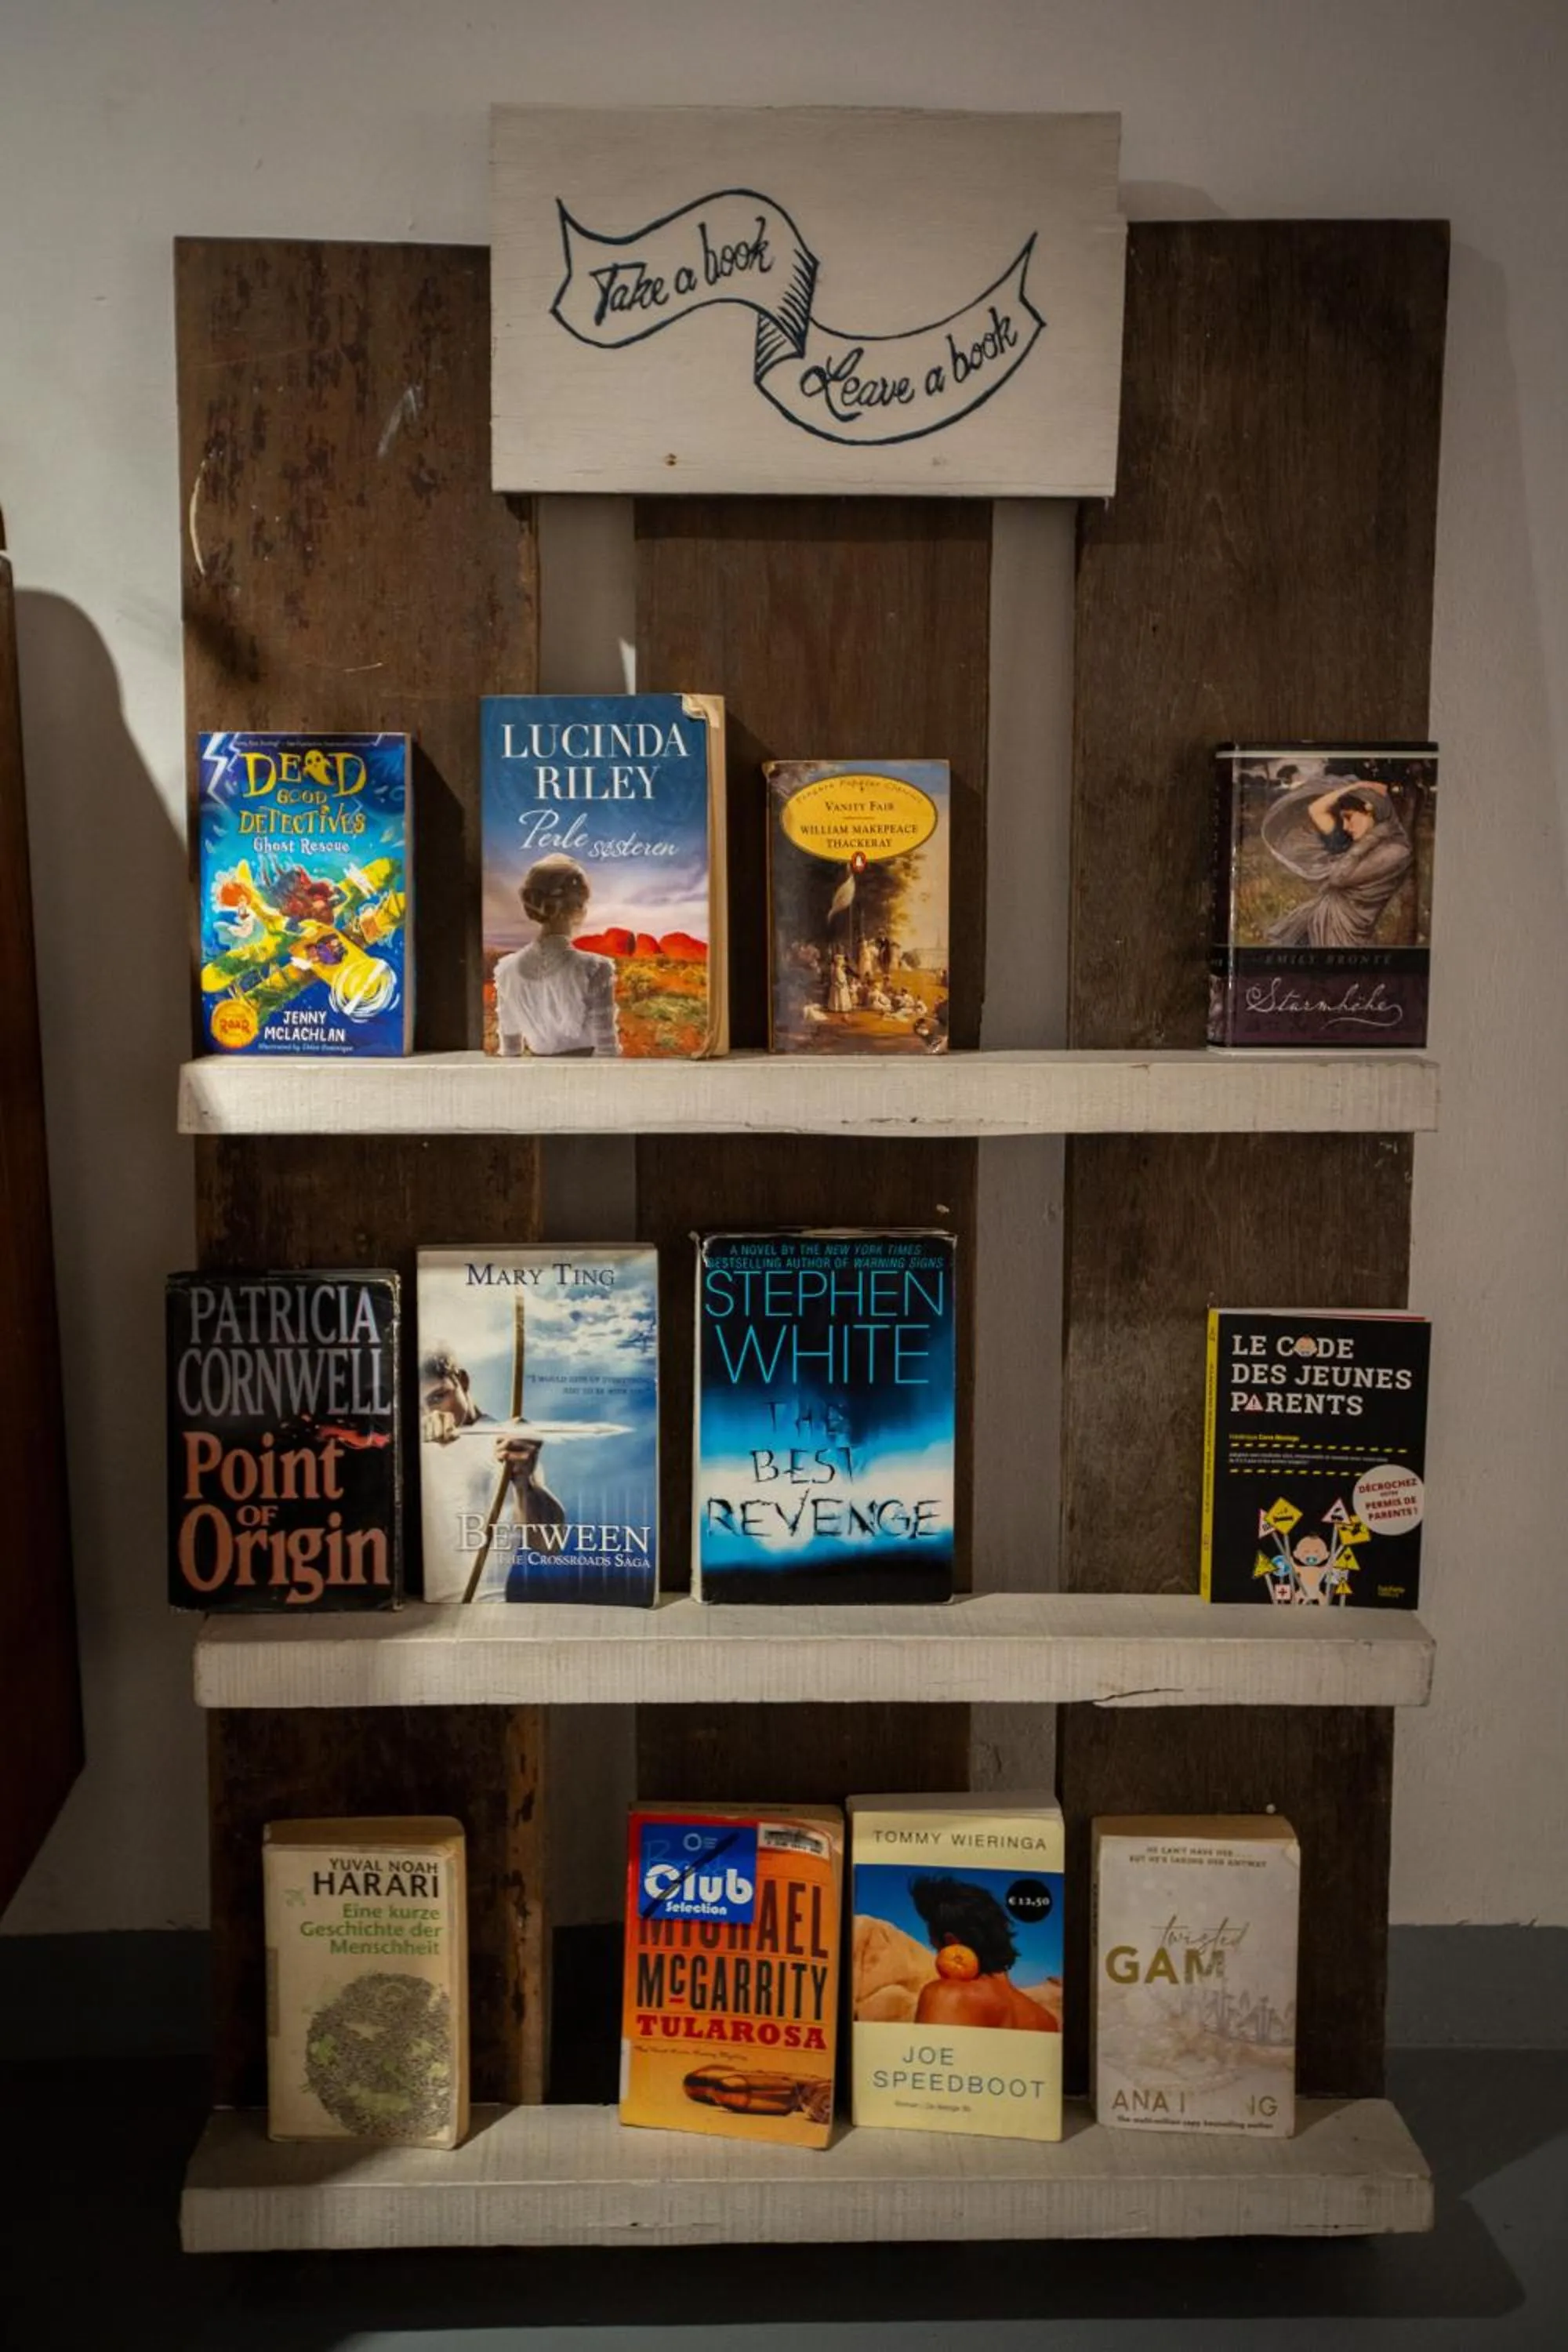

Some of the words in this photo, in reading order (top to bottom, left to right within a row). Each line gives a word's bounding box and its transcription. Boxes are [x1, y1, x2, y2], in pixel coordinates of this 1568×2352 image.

[590, 262, 667, 325] Take
[675, 267, 697, 294] a
[698, 217, 774, 285] book
[800, 347, 914, 422] Leave
[925, 365, 946, 394] a
[948, 307, 1018, 383] book
[501, 722, 691, 758] LUCINDA
[534, 766, 661, 800] RILEY
[277, 788, 328, 805] GOOD
[518, 809, 589, 850] Perle
[800, 825, 848, 835] WILLIAM
[852, 824, 917, 834] MAKEPEACE
[253, 836, 295, 854] Ghost
[300, 837, 350, 855] Rescue
[827, 838, 892, 848] THACKERAY
[283, 1011, 327, 1025] JENNY
[264, 1026, 346, 1042] MCLACHLAN
[730, 1245, 738, 1254] A
[742, 1245, 777, 1254] NOVEL
[781, 1245, 795, 1254] BY
[799, 1245, 819, 1254] THE
[826, 1245, 851, 1254] NEW
[854, 1245, 883, 1254] YORK
[887, 1245, 922, 1254] TIMES
[465, 1263, 543, 1287] MARY
[552, 1263, 615, 1287] TING
[706, 1258, 781, 1269] BESTSELLING
[786, 1258, 830, 1269] AUTHOR
[834, 1258, 848, 1269] OF
[853, 1258, 906, 1269] WARNING
[909, 1258, 944, 1269] SIGNS
[706, 1270, 943, 1317] STEPHEN
[191, 1285, 381, 1344] PATRICIA
[715, 1324, 930, 1385] WHITE
[1232, 1334, 1267, 1356] LE
[177, 1347, 391, 1417] CORNWELL
[1232, 1364, 1287, 1385] DES
[1295, 1366, 1413, 1390] JEUNES
[766, 1401, 847, 1441] THE
[182, 1431, 345, 1501] Point
[750, 1446, 855, 1484] BEST
[707, 1489, 942, 1540] REVENGE
[1365, 1497, 1401, 1510] PERMIS
[1403, 1496, 1416, 1504] DE
[237, 1505, 278, 1526] OF
[456, 1513, 651, 1553] BETWEEN
[178, 1503, 390, 1605] Origin
[528, 1552, 612, 1566] CROSSROADS
[615, 1554, 651, 1568] SAGA
[873, 1830, 942, 1846] TOMMY
[952, 1834, 1047, 1851] WIERINGA
[329, 1857, 383, 1873] YUVAL
[387, 1860, 439, 1875] NOAH
[314, 1872, 439, 1899] HARARI
[644, 1864, 753, 1905] Club
[342, 1903, 383, 1919] Eine
[388, 1904, 441, 1921] kurze
[665, 1900, 728, 1915] Selection
[300, 1920, 405, 1939] Geschichte
[410, 1922, 443, 1939] der
[330, 1939, 440, 1955] Menschheit
[636, 2014, 827, 2050] TULAROSA
[902, 2045, 955, 2066] JOE
[873, 2071, 1046, 2099] SPEEDBOOT
[1111, 2089, 1169, 2113] ANA
